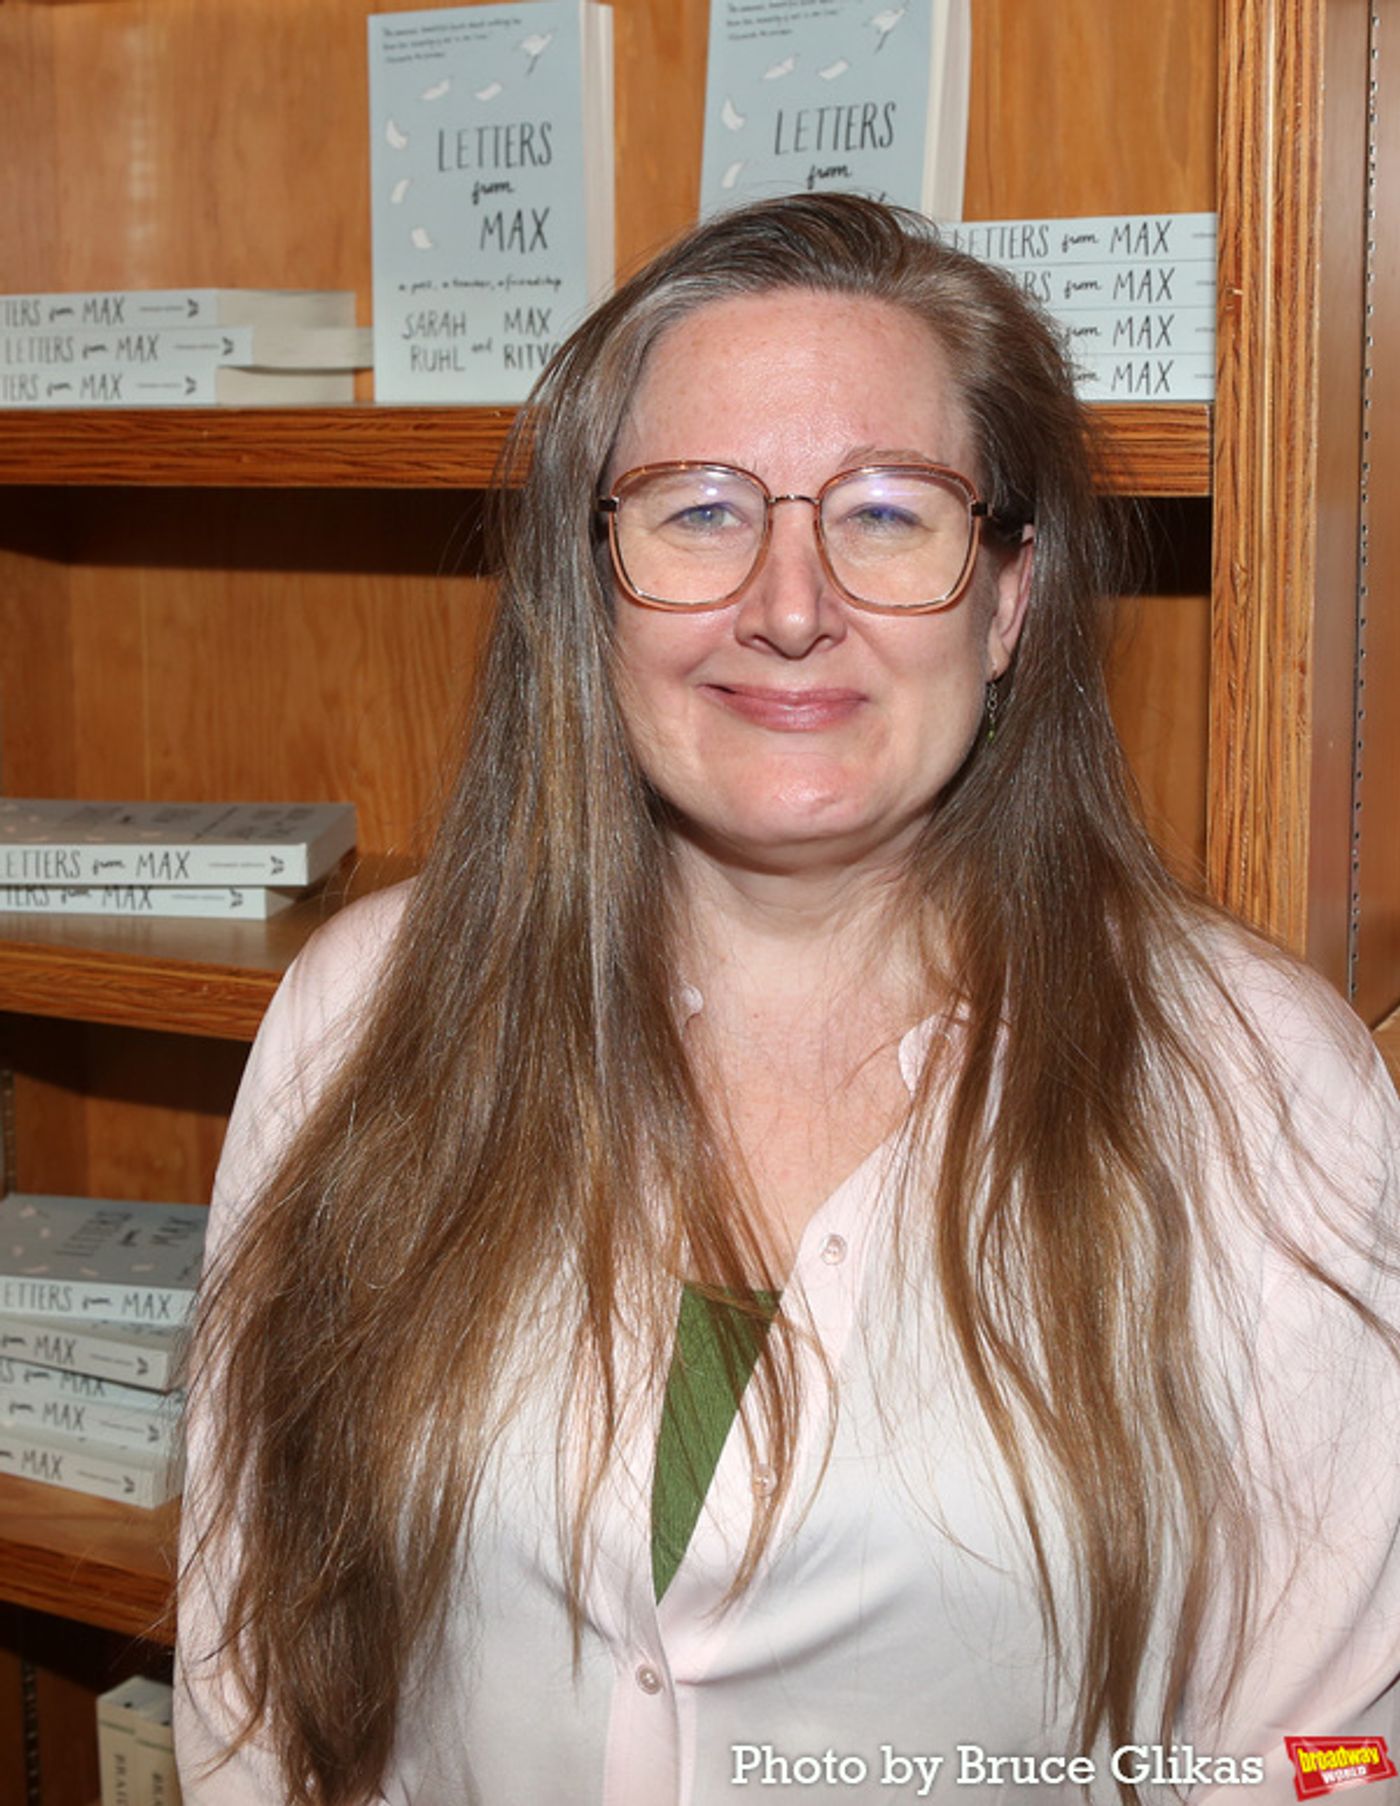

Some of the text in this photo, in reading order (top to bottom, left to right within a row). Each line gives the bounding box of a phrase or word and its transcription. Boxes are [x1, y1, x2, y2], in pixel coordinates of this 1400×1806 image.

[774, 101, 896, 155] LETTERS
[437, 121, 553, 172] LETTERS
[471, 180, 514, 205] from
[807, 164, 852, 190] from
[479, 207, 550, 254] MAX
[1062, 234, 1099, 253] from
[1109, 220, 1173, 255] MAX
[1064, 280, 1101, 299] from
[1112, 268, 1175, 303] MAX
[83, 297, 125, 326] MAX
[402, 310, 466, 340] SARAH
[504, 306, 552, 337] MAX
[1112, 314, 1175, 349] MAX
[116, 333, 159, 362] MAX
[410, 344, 466, 372] RUHL
[80, 373, 123, 400] MAX
[1110, 360, 1174, 395] MAX
[135, 850, 190, 880] MAX
[102, 886, 153, 910] MAX
[121, 1291, 172, 1319] MAX
[33, 1334, 77, 1367] MAX
[42, 1401, 86, 1432] MAX
[21, 1449, 63, 1481] MAX
